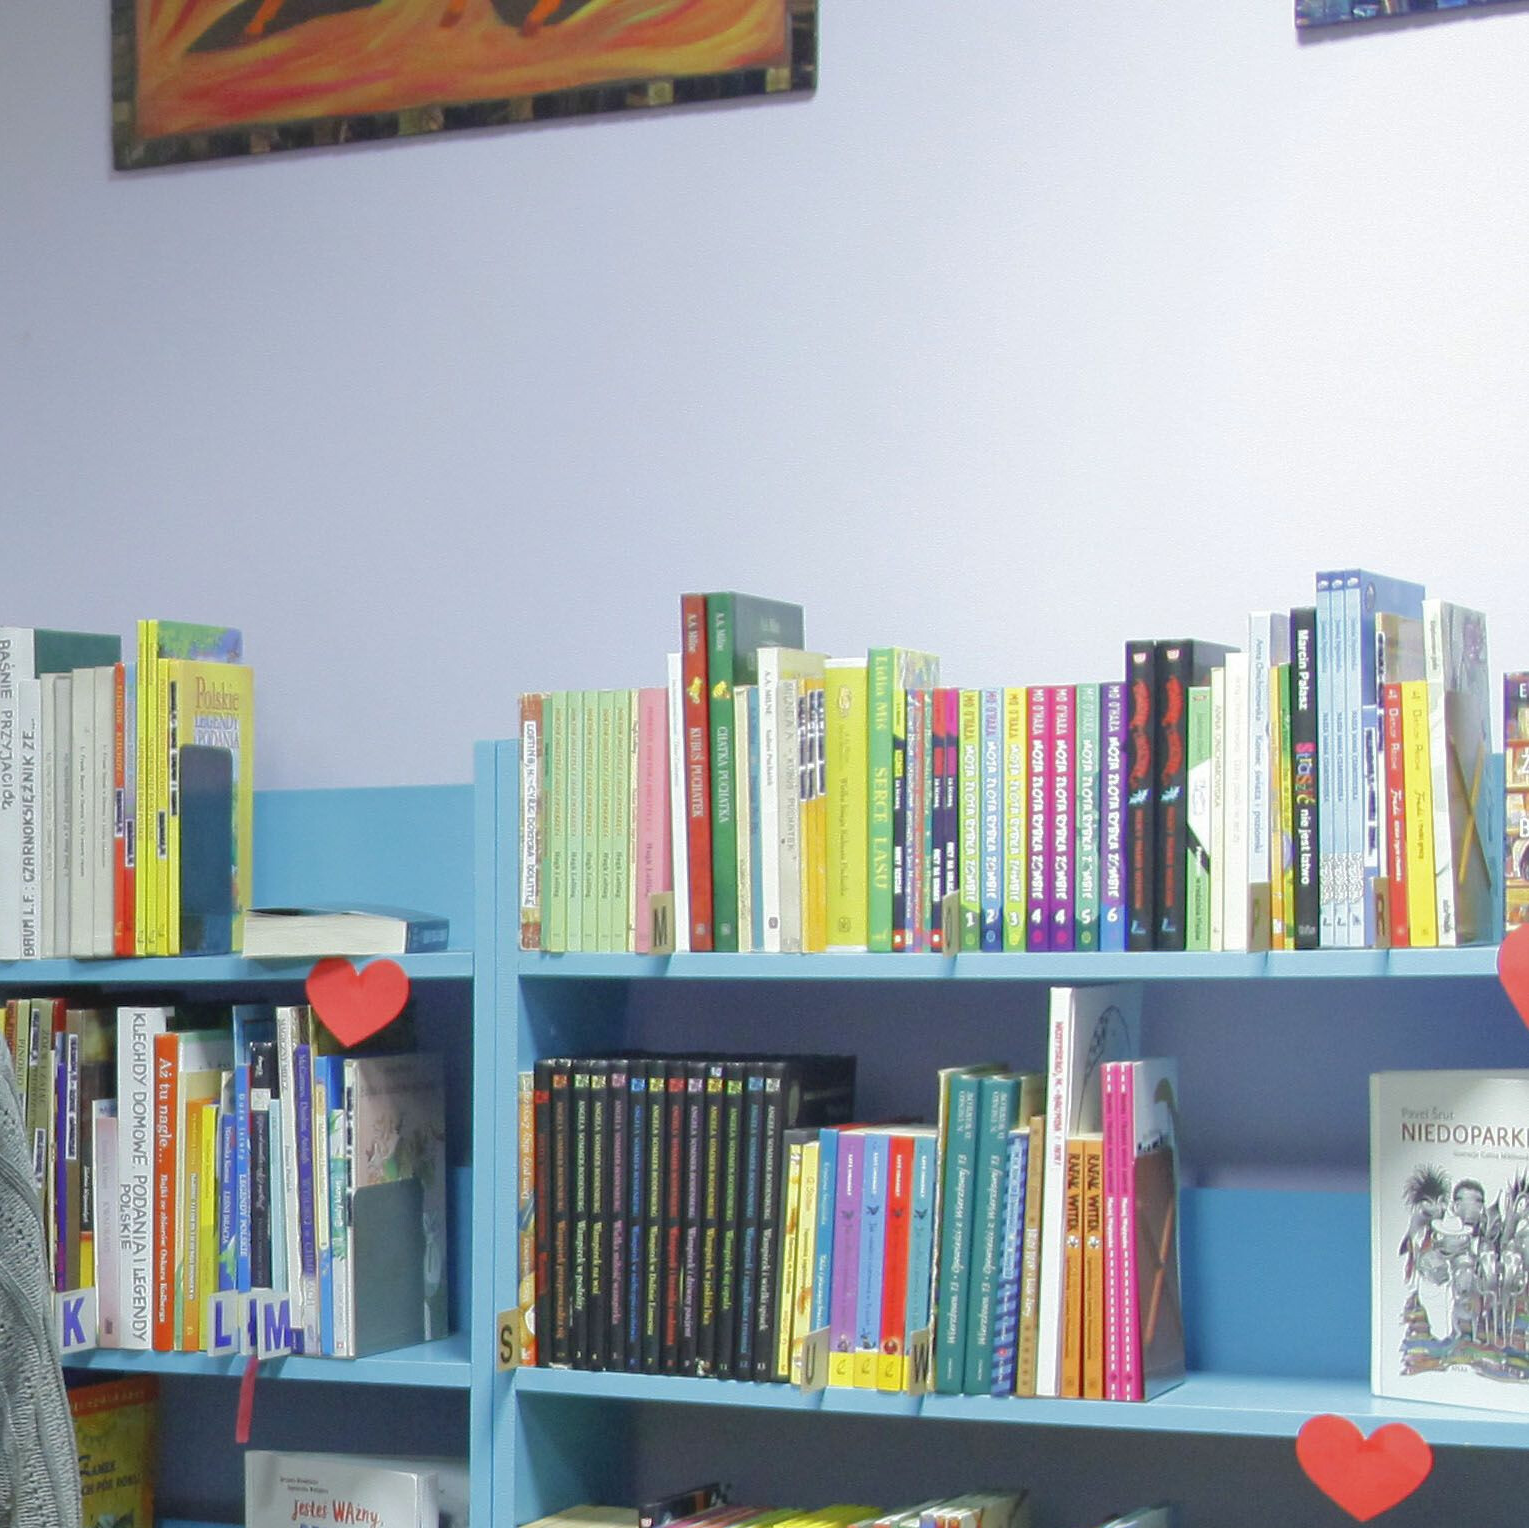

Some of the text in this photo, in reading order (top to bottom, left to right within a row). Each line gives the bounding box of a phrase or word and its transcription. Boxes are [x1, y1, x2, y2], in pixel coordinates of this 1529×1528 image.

[1254, 639, 1264, 659] Anna
[1297, 630, 1309, 669] Marcin
[195, 676, 239, 711] Polskie
[195, 713, 239, 730] LEGENDY
[1, 709, 16, 811] PRZYJACIÓŁ
[964, 745, 975, 777] MOJA
[985, 741, 997, 772] MOJA
[1009, 744, 1020, 775] MOJA
[1032, 739, 1043, 772] MOJA
[1055, 739, 1066, 772] MOJA
[1081, 740, 1093, 771] MOJA
[1107, 737, 1120, 769] MOJA
[690, 728, 705, 817] KUBUŚ PUCHATEK
[717, 727, 730, 822] CHATKA PUCHATKA
[874, 767, 888, 889] SERCE LASU
[964, 818, 975, 855] RYBKA
[985, 815, 997, 851] RYBKA
[1009, 817, 1020, 854] RYBKA
[1032, 814, 1043, 851] RYBKA
[1055, 814, 1066, 851] RYBKA
[1081, 814, 1093, 851] RYBKA
[1107, 812, 1120, 849] RYBKA
[1299, 810, 1309, 827] nie
[1298, 830, 1310, 851] jest
[964, 860, 975, 901] ZOMBIE
[985, 856, 997, 898] ZOMBIE
[1009, 860, 1020, 901] ZOMBIE
[1032, 856, 1043, 900] ZOMBIE
[1055, 856, 1066, 900] ZOMBIE
[1081, 856, 1093, 898] ZOMBIE
[1107, 853, 1120, 896] ZOMBIE
[653, 906, 668, 947] M
[986, 909, 998, 923] 2
[22, 919, 36, 956] BAUM
[133, 1013, 147, 1085] KLECHDY
[159, 1058, 172, 1077] Aż
[120, 1185, 132, 1249] POLSKIE
[133, 1175, 147, 1254] PODANIA
[1067, 1194, 1079, 1232] WITEK
[1087, 1194, 1100, 1232] WITEK
[63, 1297, 86, 1347] K
[133, 1268, 147, 1341] LEGENDY
[215, 1301, 232, 1347] L
[264, 1300, 291, 1349] M
[500, 1326, 514, 1364] S
